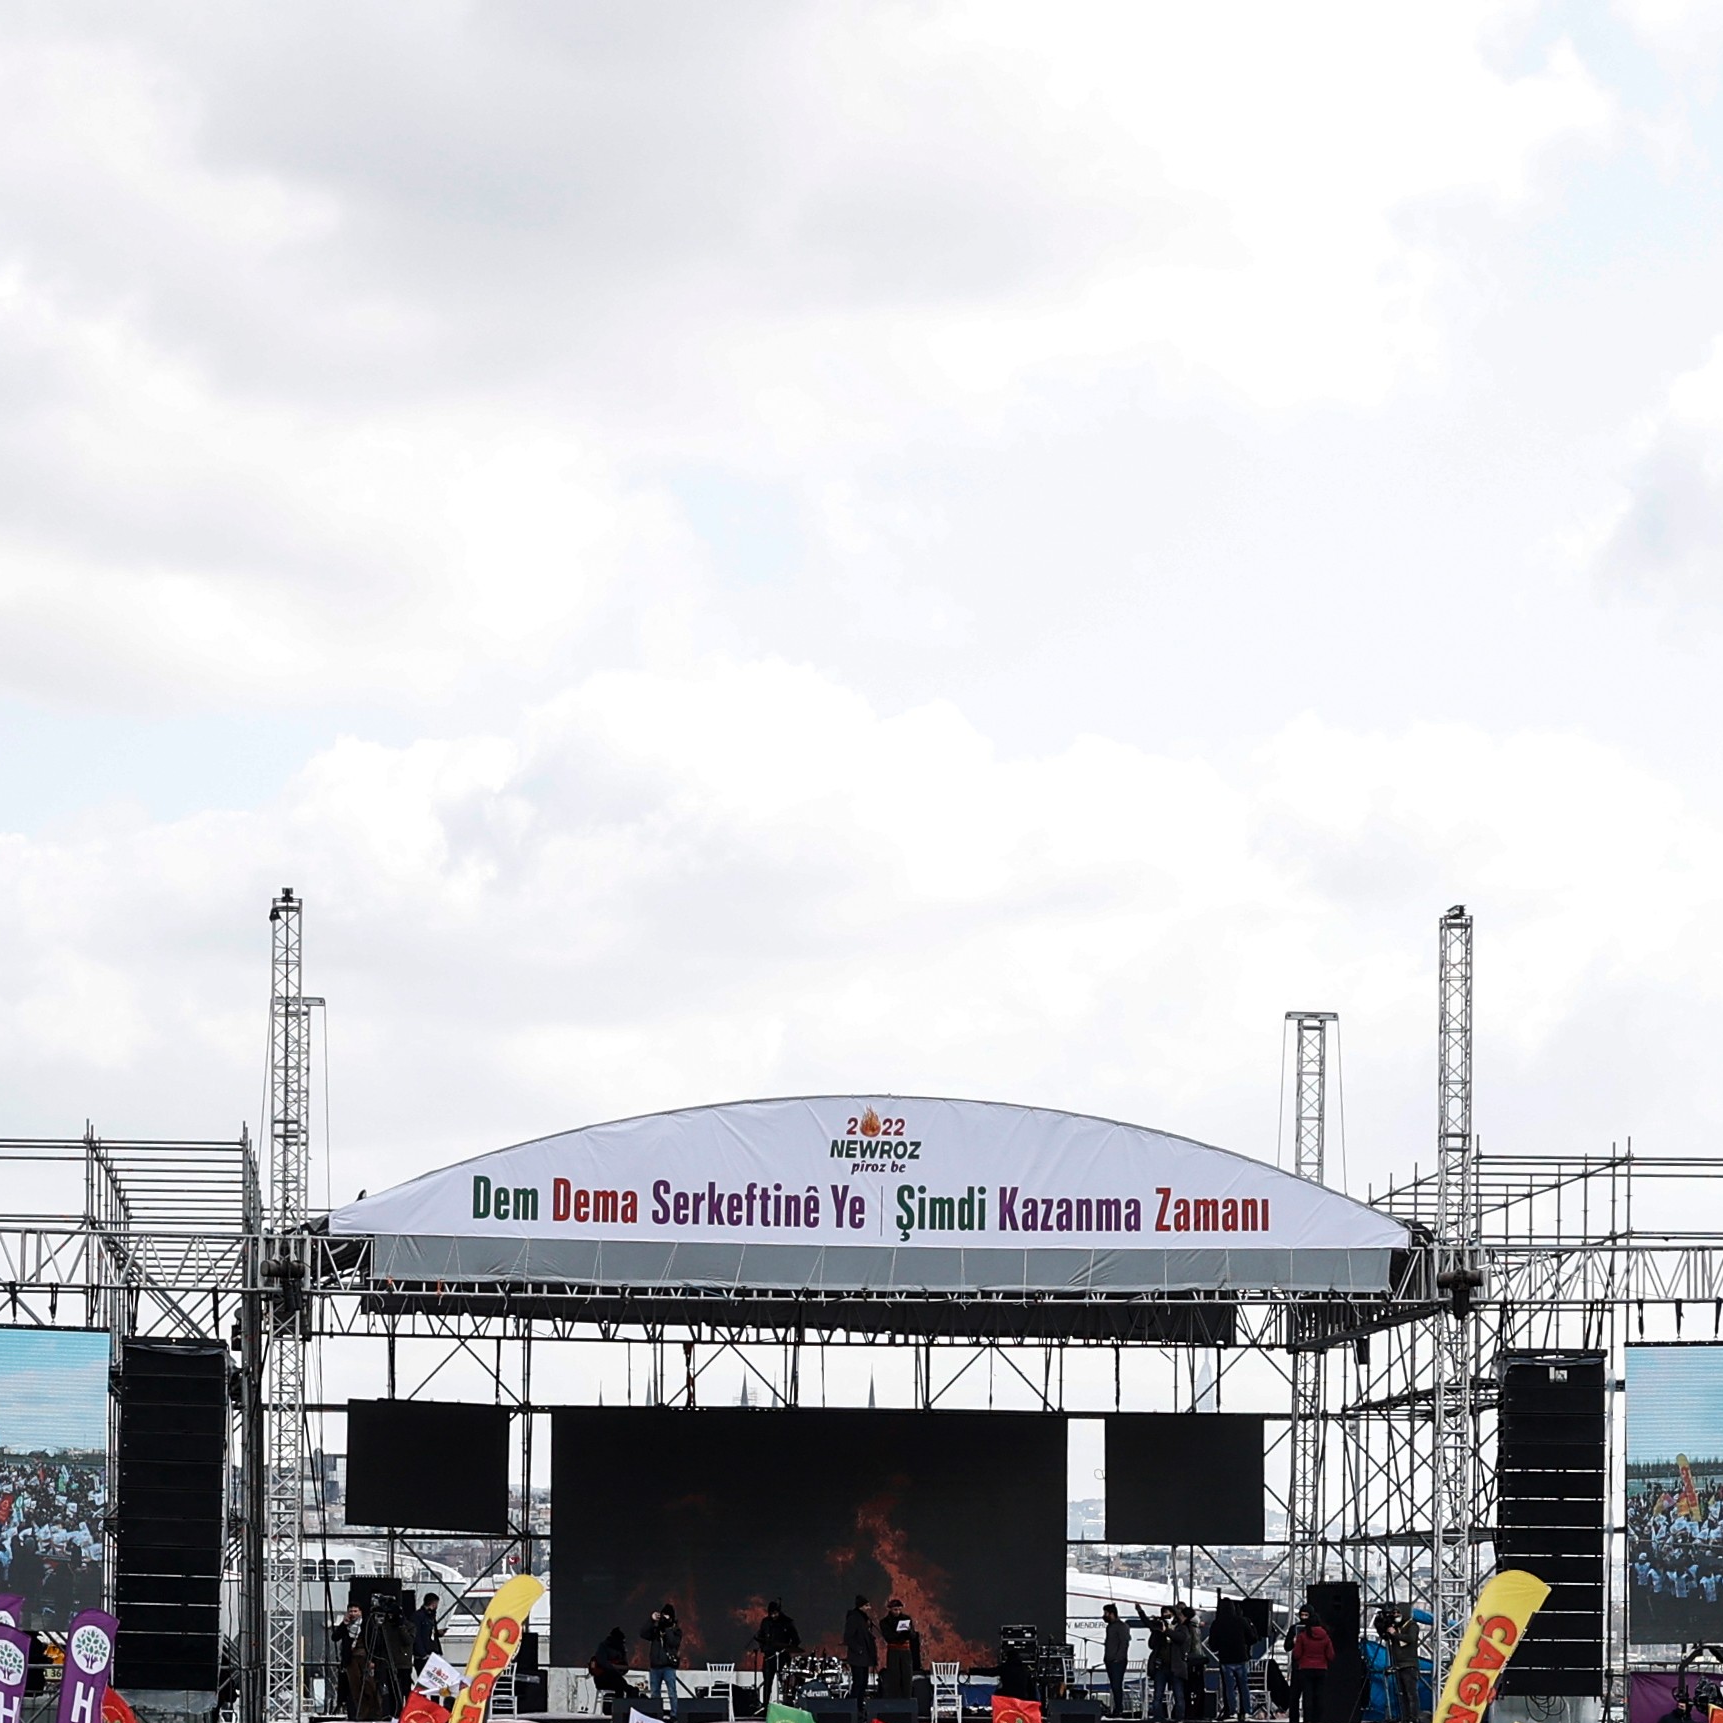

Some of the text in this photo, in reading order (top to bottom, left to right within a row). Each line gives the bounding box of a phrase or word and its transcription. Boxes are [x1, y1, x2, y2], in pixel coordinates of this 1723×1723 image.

[829, 1140, 922, 1160] NEWROZ
[891, 1160, 906, 1174] be
[472, 1174, 1270, 1244] Dem Dema Serkeftinê Ye Şimdi Kazanma Zamanı
